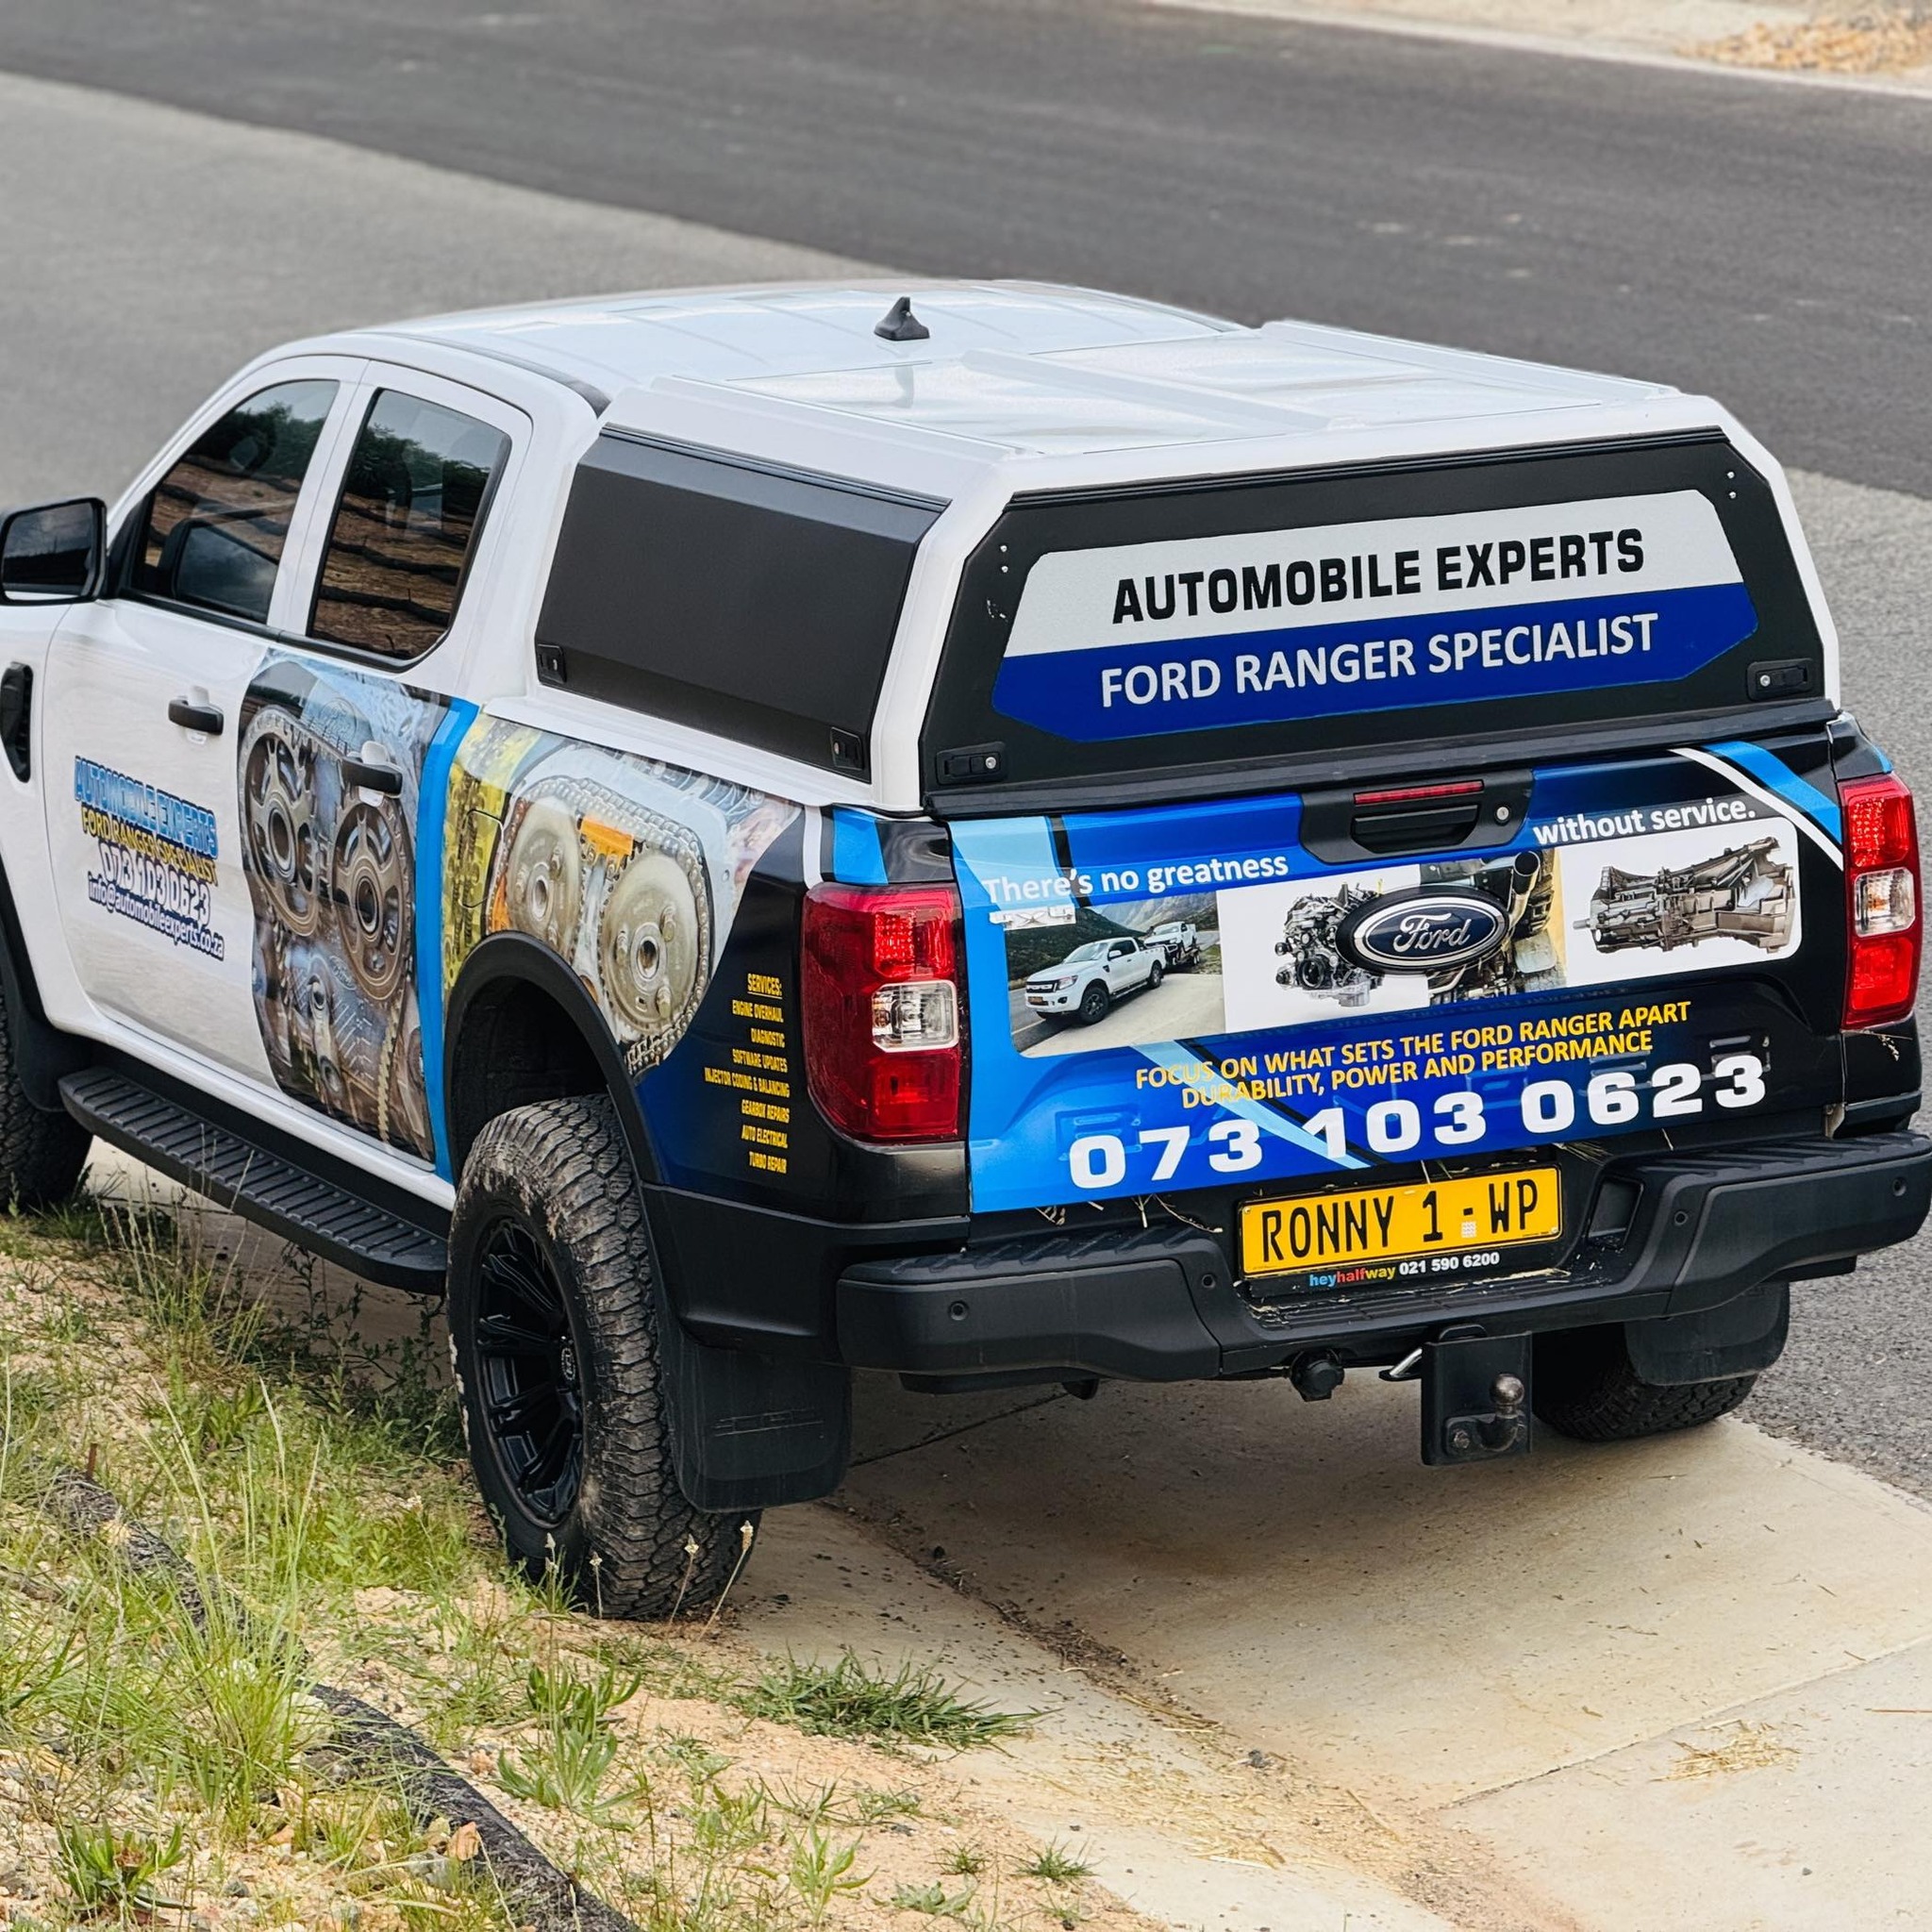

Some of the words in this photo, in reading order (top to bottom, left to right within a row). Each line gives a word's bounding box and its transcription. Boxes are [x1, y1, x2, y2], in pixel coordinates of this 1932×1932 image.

[1111, 548, 1422, 625] AUTOMOBILE
[1437, 528, 1644, 591] EXPERTS
[1101, 655, 1222, 708] FORD
[1237, 637, 1417, 694] RANGER
[1429, 613, 1659, 674] SPECIALIST
[75, 755, 157, 834] AUTOMOBILE
[157, 789, 219, 860] EXPERTS
[81, 803, 112, 841] FORD
[112, 815, 157, 858] RANGER
[156, 834, 218, 886] SPECIALIST
[1101, 870, 1140, 891] no
[1148, 855, 1289, 893] greatness
[1532, 808, 1647, 845] without
[1652, 797, 1757, 832] service.
[99, 841, 136, 891] 073
[135, 853, 168, 907] 103
[167, 864, 210, 926] 0623
[1392, 911, 1473, 952] Ford
[732, 999, 754, 1018] ENGINE
[754, 1002, 785, 1023] OVERHAUL
[747, 973, 783, 996] SERVICES:
[732, 1048, 761, 1069] SOFTWARE
[762, 1055, 789, 1074] UPDATES
[751, 1027, 786, 1048] DIAGNOSTIC
[1136, 1061, 1215, 1091] FOCUS
[1220, 1056, 1258, 1080] ON
[1263, 1046, 1336, 1074] WHAT
[1341, 1039, 1394, 1065] SETS
[1400, 1033, 1444, 1058] THE
[1451, 1024, 1513, 1051] FORD
[1523, 1011, 1614, 1041] RANGER
[1618, 1001, 1691, 1029] APART
[704, 1067, 731, 1085] INJECTOR
[732, 1072, 753, 1091] CODING
[758, 1076, 791, 1098] BALANCING
[1182, 1071, 1325, 1108] DURABILITY,
[1332, 1058, 1418, 1090] POWER
[1424, 1052, 1475, 1079] AND
[1482, 1030, 1654, 1072] PERFORMANCE
[741, 1099, 766, 1118] GEARBOX
[767, 1104, 791, 1124] REPAIRS
[741, 1124, 756, 1141] AUTO
[757, 1127, 788, 1149] ELECTRICAL
[1069, 1120, 1263, 1189] 073
[1301, 1091, 1487, 1160] 103
[1521, 1054, 1766, 1134] 0623
[749, 1151, 767, 1169] TURBO
[767, 1156, 788, 1174] REPAIR
[1262, 1195, 1394, 1262] RONNY
[1422, 1191, 1443, 1242] 1
[1489, 1179, 1538, 1234] WP
[1309, 1265, 1396, 1288] heyhalfway
[1399, 1261, 1426, 1275] 021
[1431, 1257, 1460, 1273] 590
[1462, 1252, 1501, 1268] 6200
